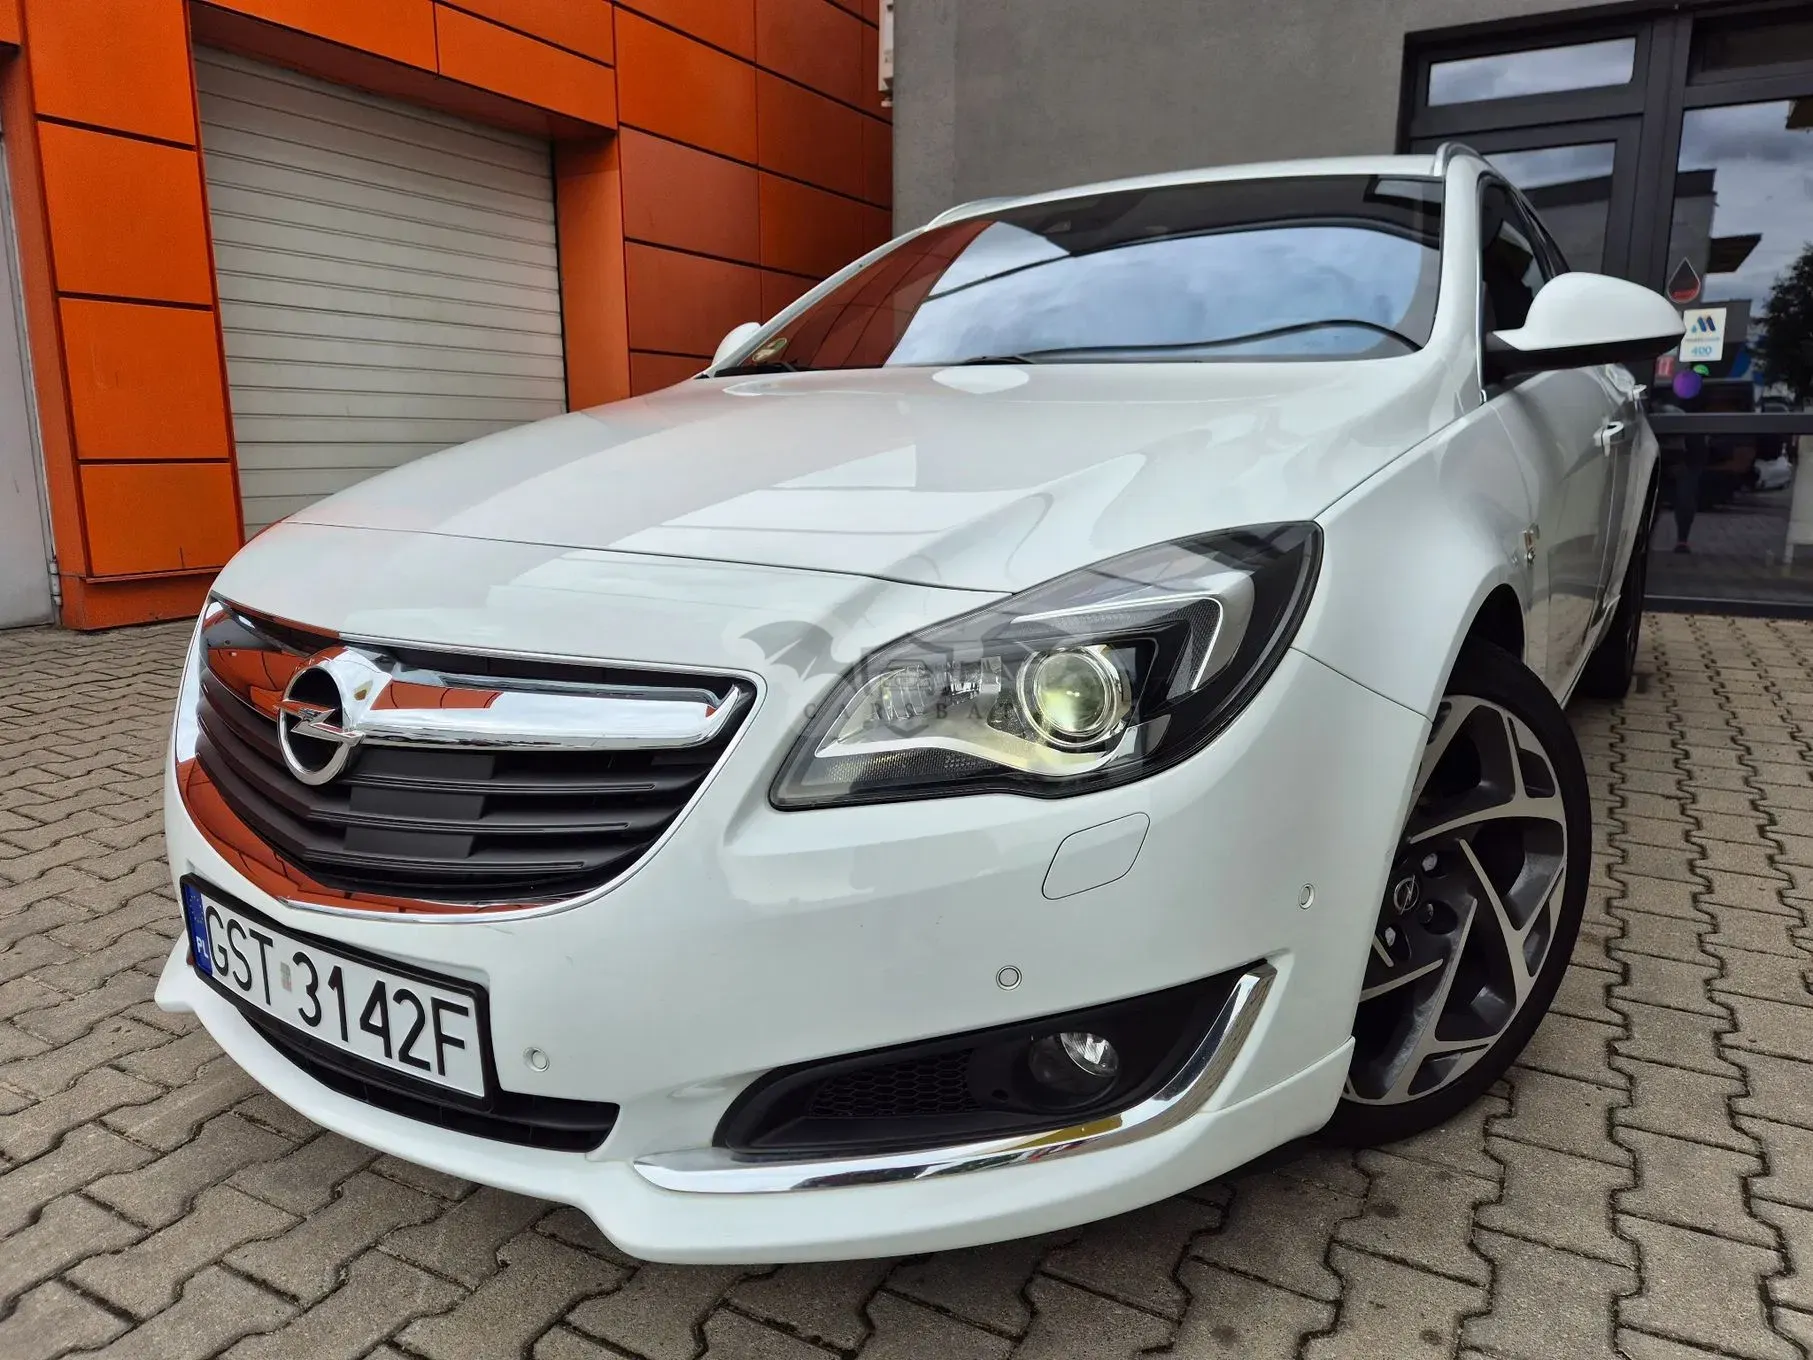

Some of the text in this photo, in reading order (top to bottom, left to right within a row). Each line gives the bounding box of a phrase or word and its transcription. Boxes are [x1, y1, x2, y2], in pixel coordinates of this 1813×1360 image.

[195, 935, 209, 959] PL
[205, 905, 470, 1077] GST 3142F
